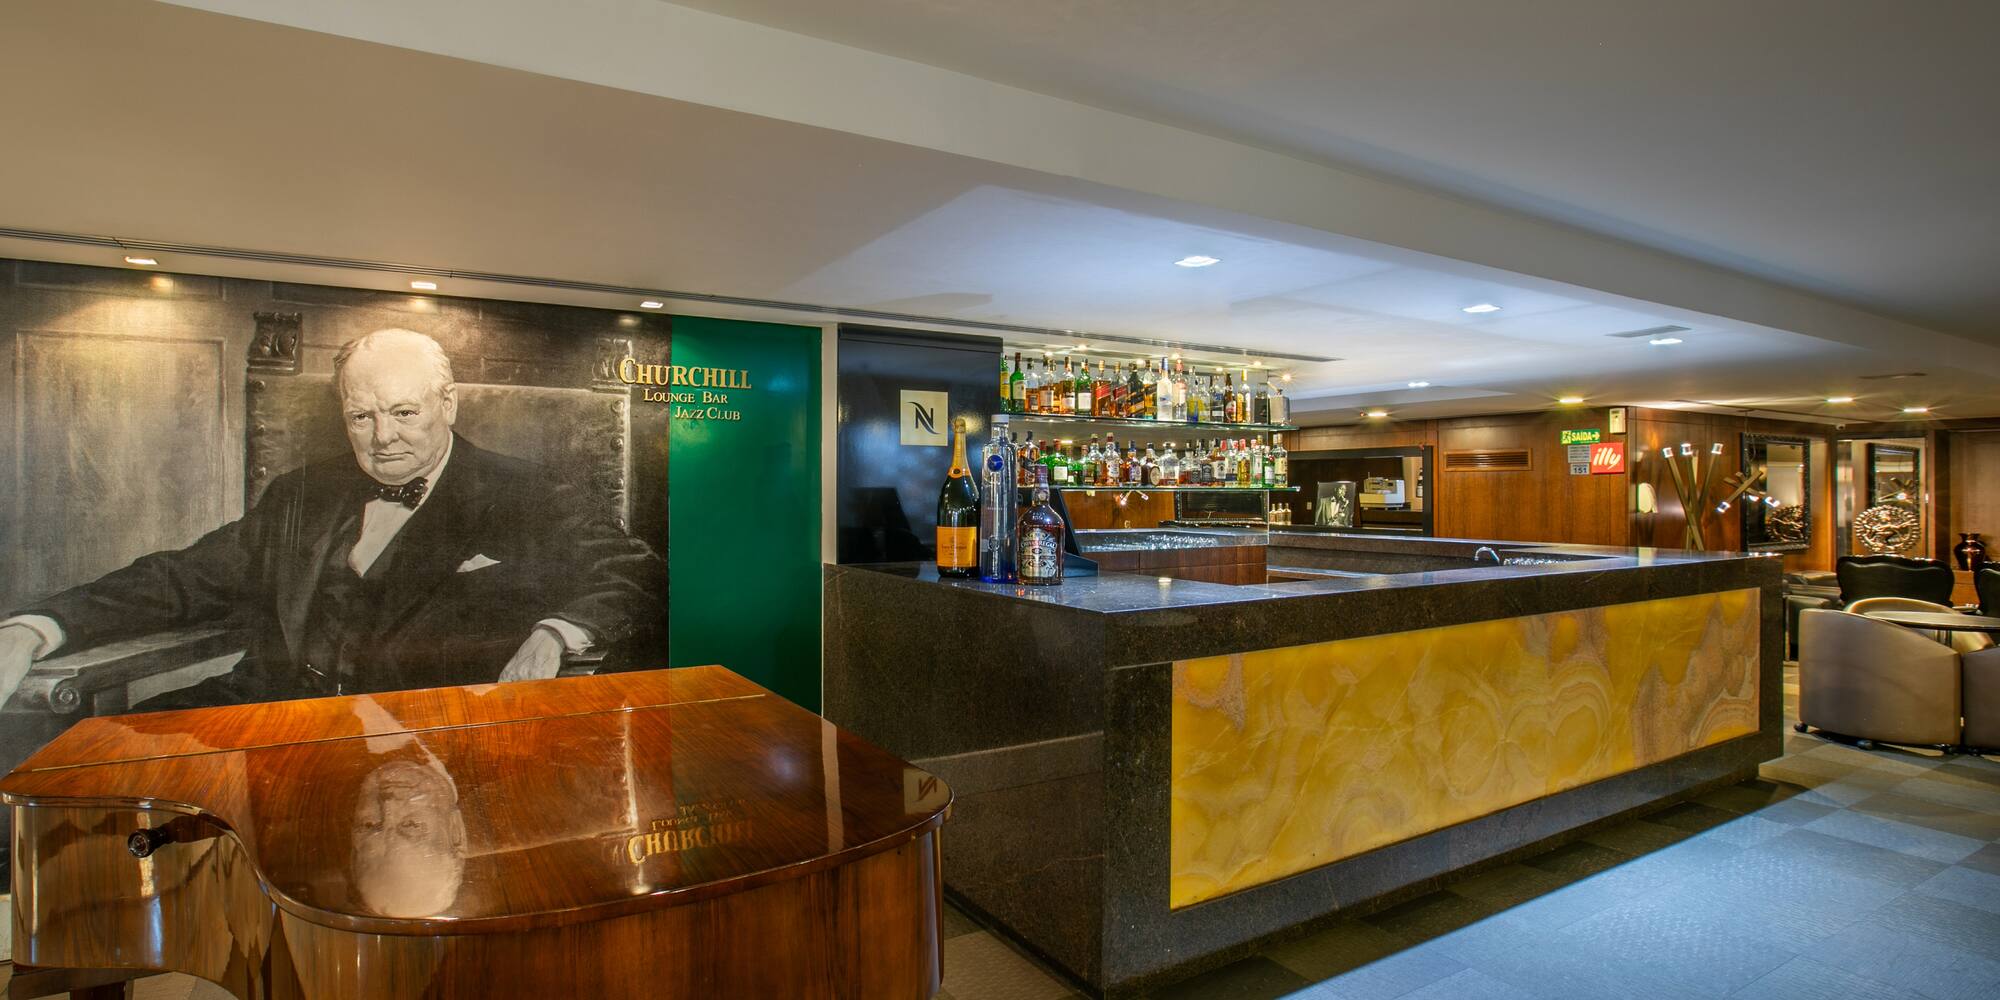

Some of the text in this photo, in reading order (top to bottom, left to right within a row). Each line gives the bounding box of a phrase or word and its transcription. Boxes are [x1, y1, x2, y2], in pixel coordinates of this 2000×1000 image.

[619, 357, 752, 389] CHURCHILL
[643, 389, 729, 404] LOUNGE BAR
[674, 405, 741, 421] JAZZ CLUB
[906, 401, 942, 435] N
[1592, 447, 1621, 470] illy
